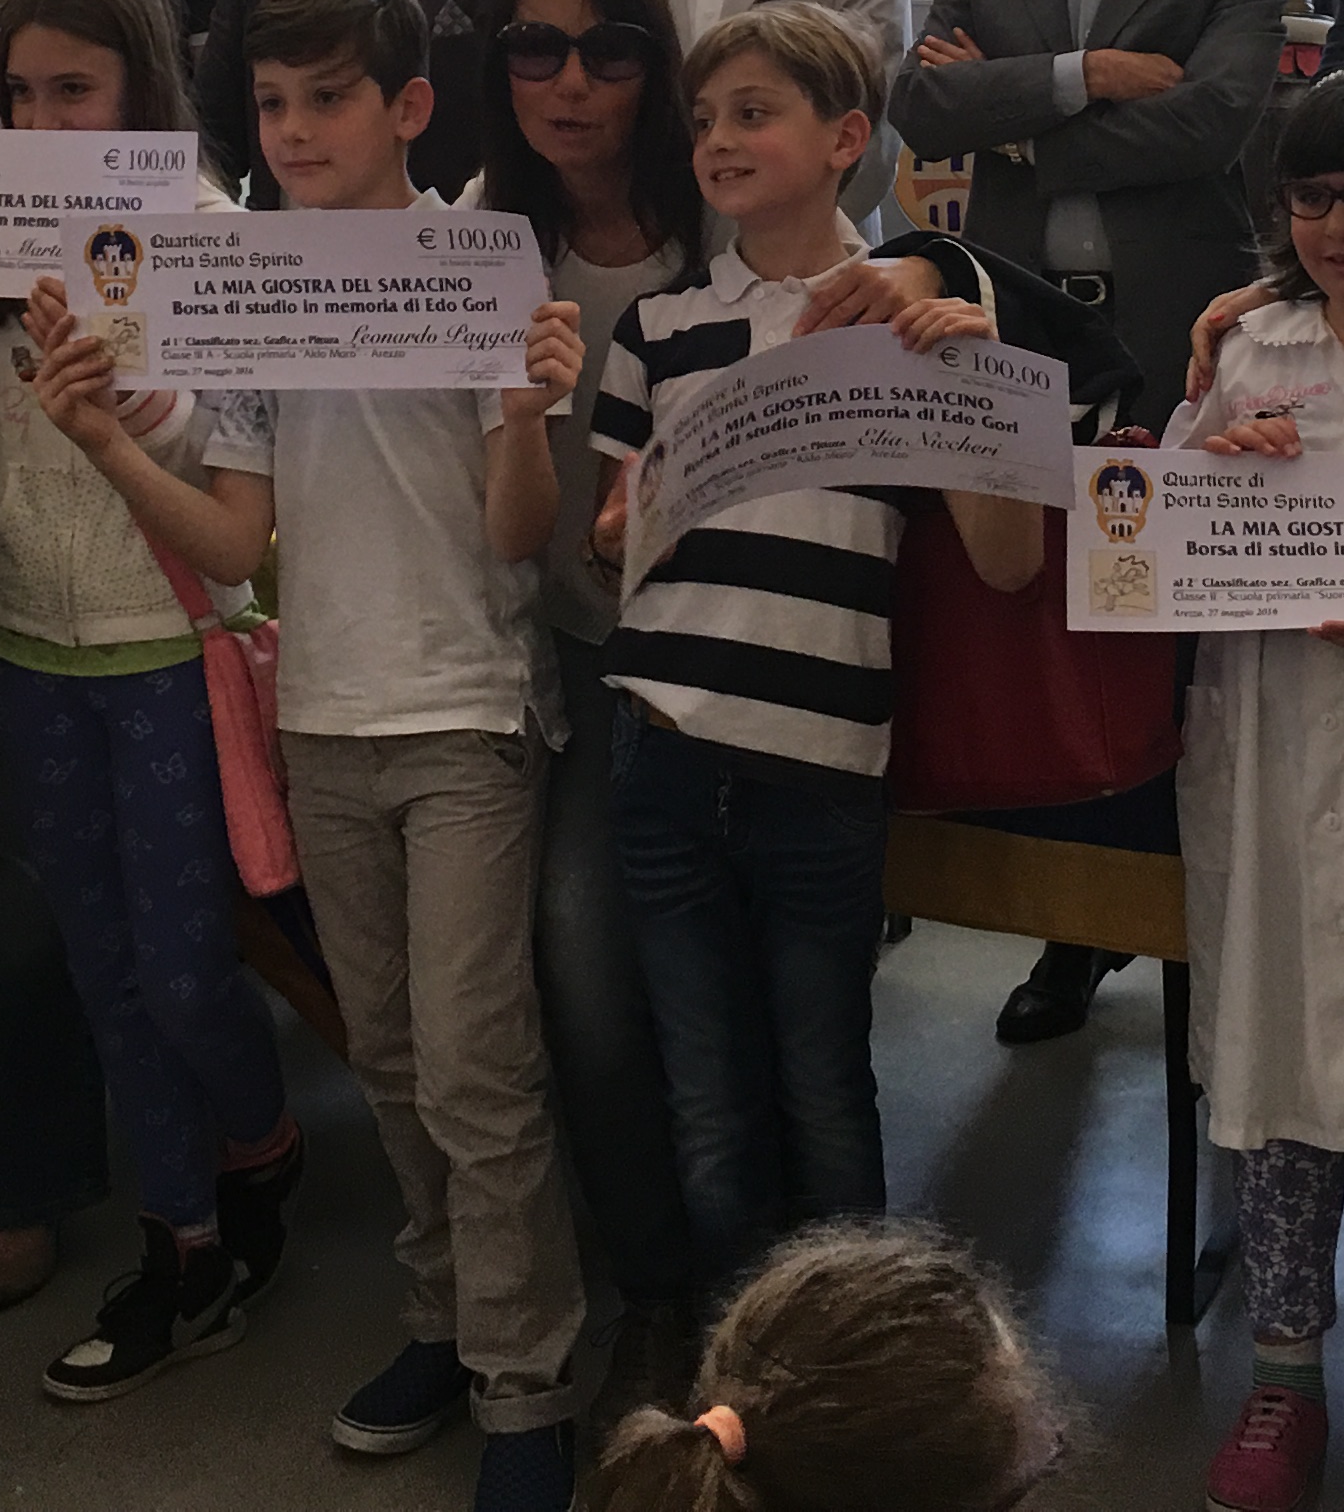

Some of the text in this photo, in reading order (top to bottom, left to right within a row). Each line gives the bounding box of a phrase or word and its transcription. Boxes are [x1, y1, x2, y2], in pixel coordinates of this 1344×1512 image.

[31, 195, 59, 209] DEL
[64, 195, 142, 211] SARACINO
[150, 231, 240, 249] Quartiere di
[416, 227, 521, 252] € 100,00
[151, 252, 303, 272] Porta Santo Spirito
[194, 277, 472, 295] LA MIA GIOSTRA DEL SARACINO
[172, 297, 498, 315] Borsa di studio in memoria di Edo Gori
[443, 324, 530, 349] Paggett
[938, 346, 961, 368] €
[974, 352, 1050, 390] 100,00
[763, 390, 842, 418] GIOSTRA
[849, 386, 884, 401] DEL
[890, 387, 994, 411] SARACINO
[805, 406, 1018, 434] in memoria di Edo Gori
[1162, 471, 1264, 488] Quartiere di
[1162, 492, 1335, 512] Porta Santo Spirito
[1211, 521, 1235, 536] LA
[1242, 521, 1281, 536] MIA
[1186, 541, 1238, 556] Borsa
[1244, 541, 1262, 556] di
[1269, 541, 1328, 556] studio
